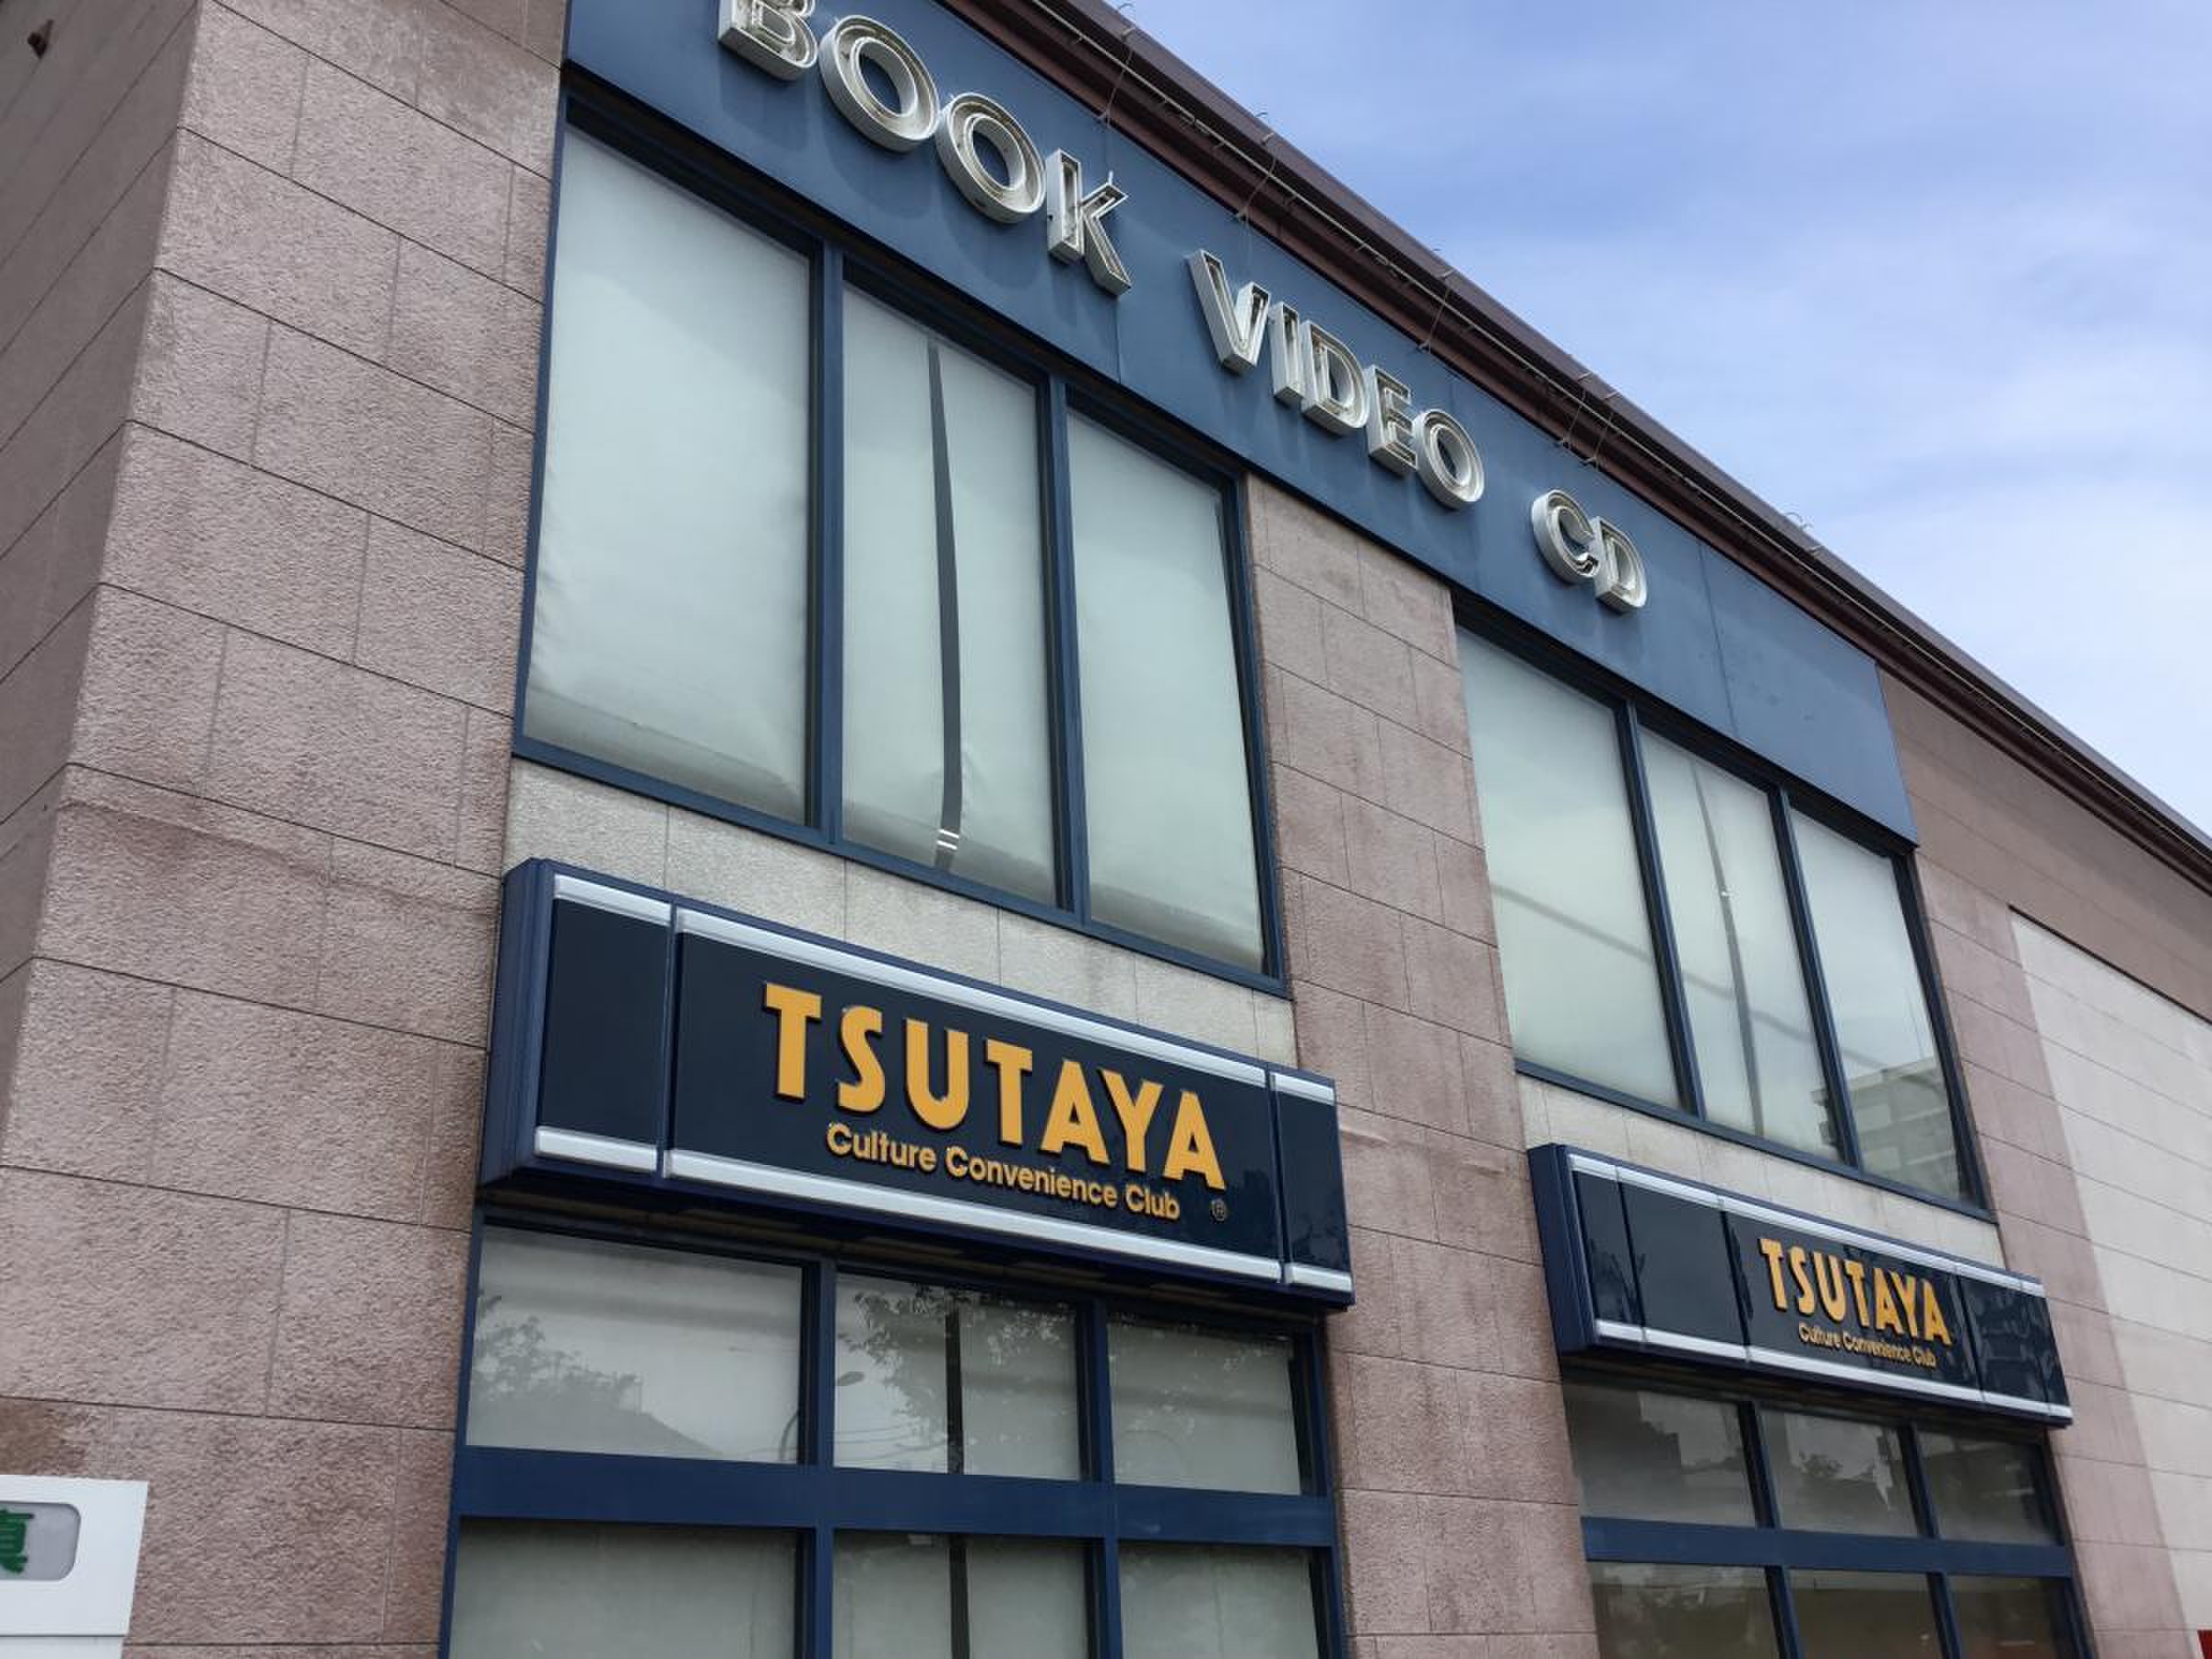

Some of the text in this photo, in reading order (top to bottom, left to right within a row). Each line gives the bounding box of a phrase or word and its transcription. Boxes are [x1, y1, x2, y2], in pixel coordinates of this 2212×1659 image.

[718, 0, 1649, 613] BOOK VIDEO CD
[764, 982, 1227, 1191] TSUTAYA
[826, 1121, 1182, 1221] Culture Convenience Club
[1759, 1237, 1953, 1347] TSUTAYA
[1798, 1323, 1936, 1367] Culture Convenience Club
